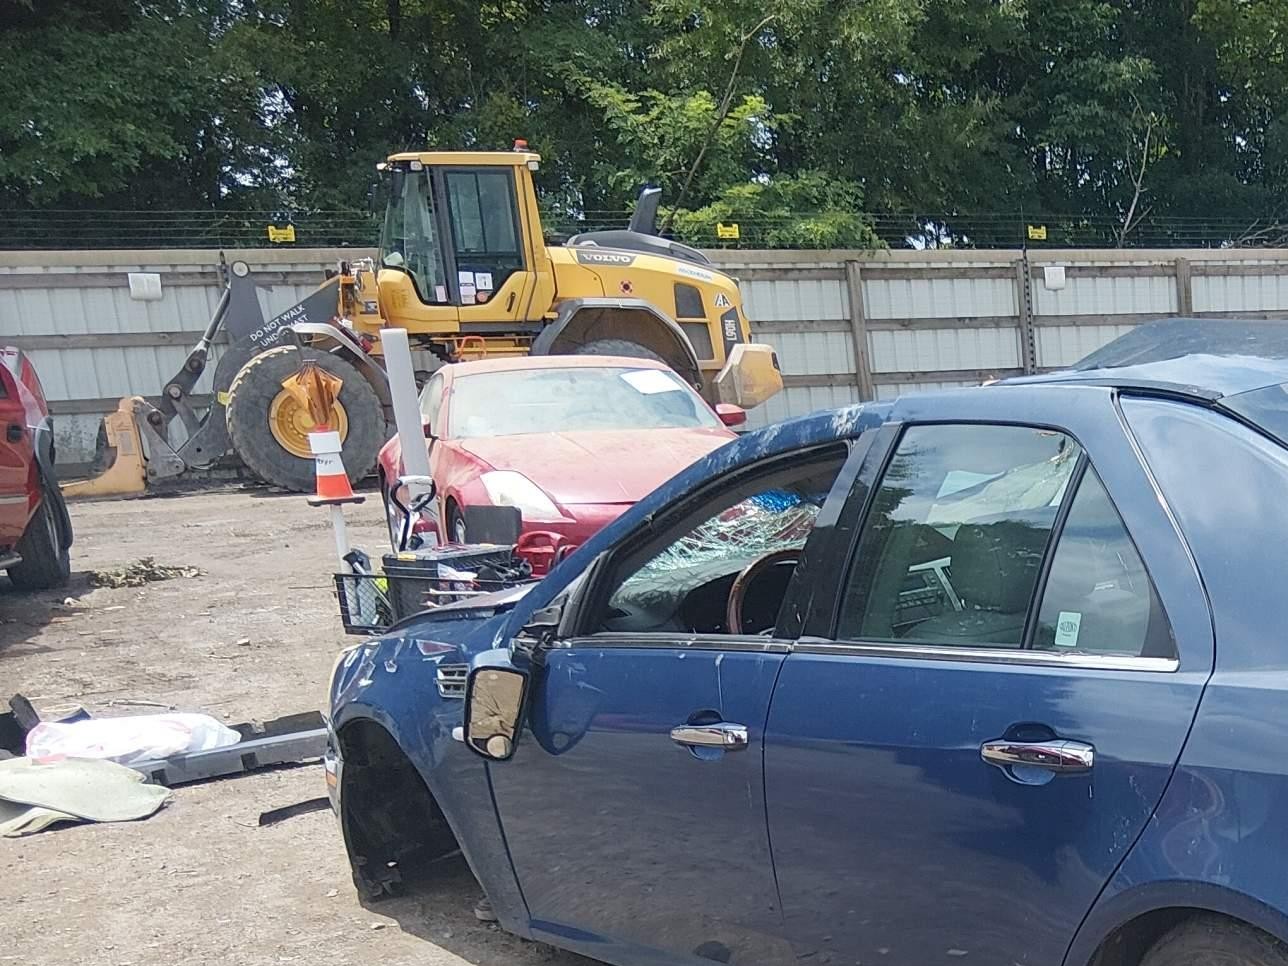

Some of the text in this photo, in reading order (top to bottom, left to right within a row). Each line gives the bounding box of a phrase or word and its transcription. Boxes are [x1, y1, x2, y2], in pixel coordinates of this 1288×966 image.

[580, 253, 631, 263] VOLVO
[249, 304, 306, 342] DO NOT WALK
